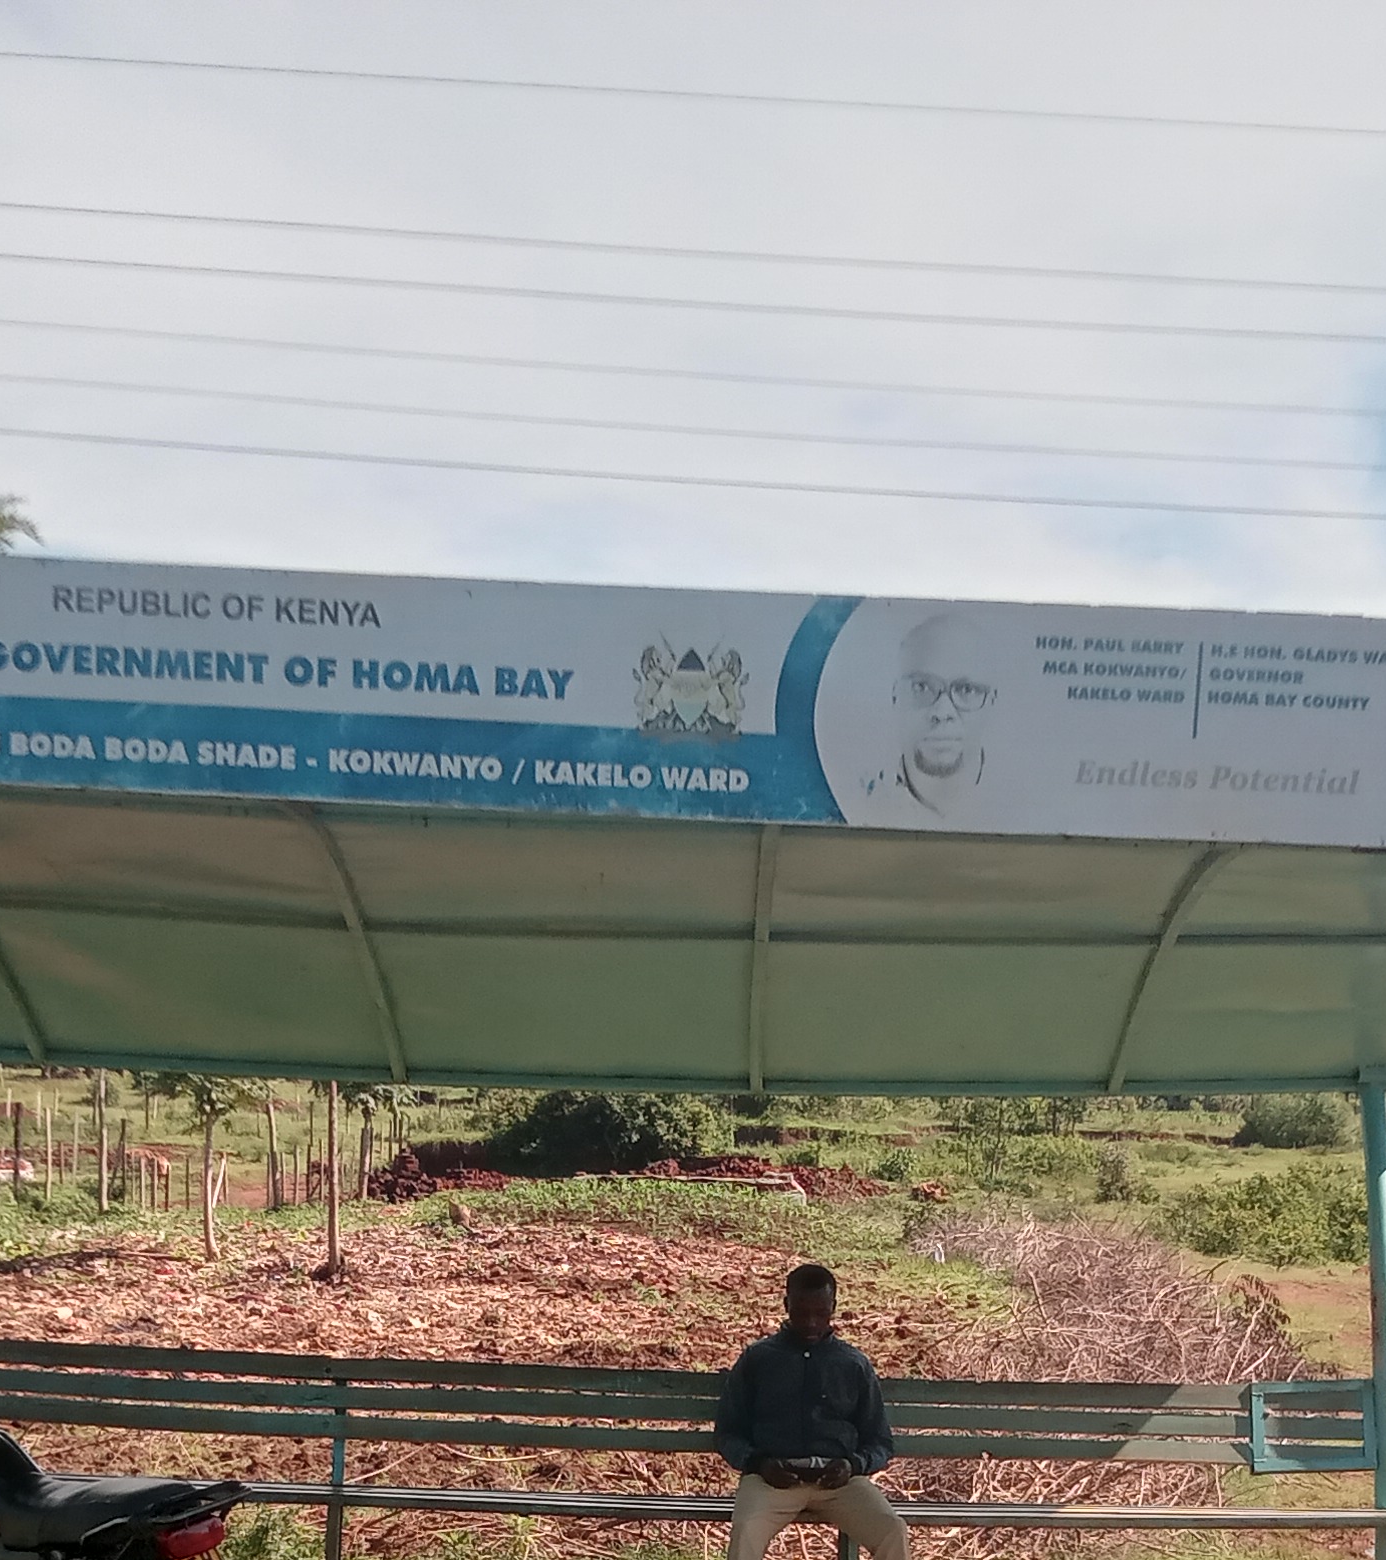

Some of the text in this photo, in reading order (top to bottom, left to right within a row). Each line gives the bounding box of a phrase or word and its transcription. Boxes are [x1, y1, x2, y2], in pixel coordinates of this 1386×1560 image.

[53, 585, 381, 629] REPUBLIC OF KENYA
[1083, 637, 1126, 653] PAUL
[1293, 647, 1357, 664] GLADYS
[1042, 661, 1078, 676] MCA
[1209, 667, 1304, 684] GOVERNOR
[284, 656, 337, 689] OF
[352, 659, 480, 696] HOMA
[494, 666, 574, 701] BAY
[1067, 686, 1185, 704] KAKELO WARD
[1207, 690, 1371, 711] HOMA BAY COUNTY
[10, 731, 95, 761] BODA
[104, 735, 189, 765] BODA
[197, 740, 296, 770] SHADE
[329, 746, 503, 782] KOKWANYO
[512, 758, 525, 786] /
[535, 759, 652, 790] KAKELO
[662, 765, 750, 794] WARD
[1074, 759, 1361, 796] Endless Potential
